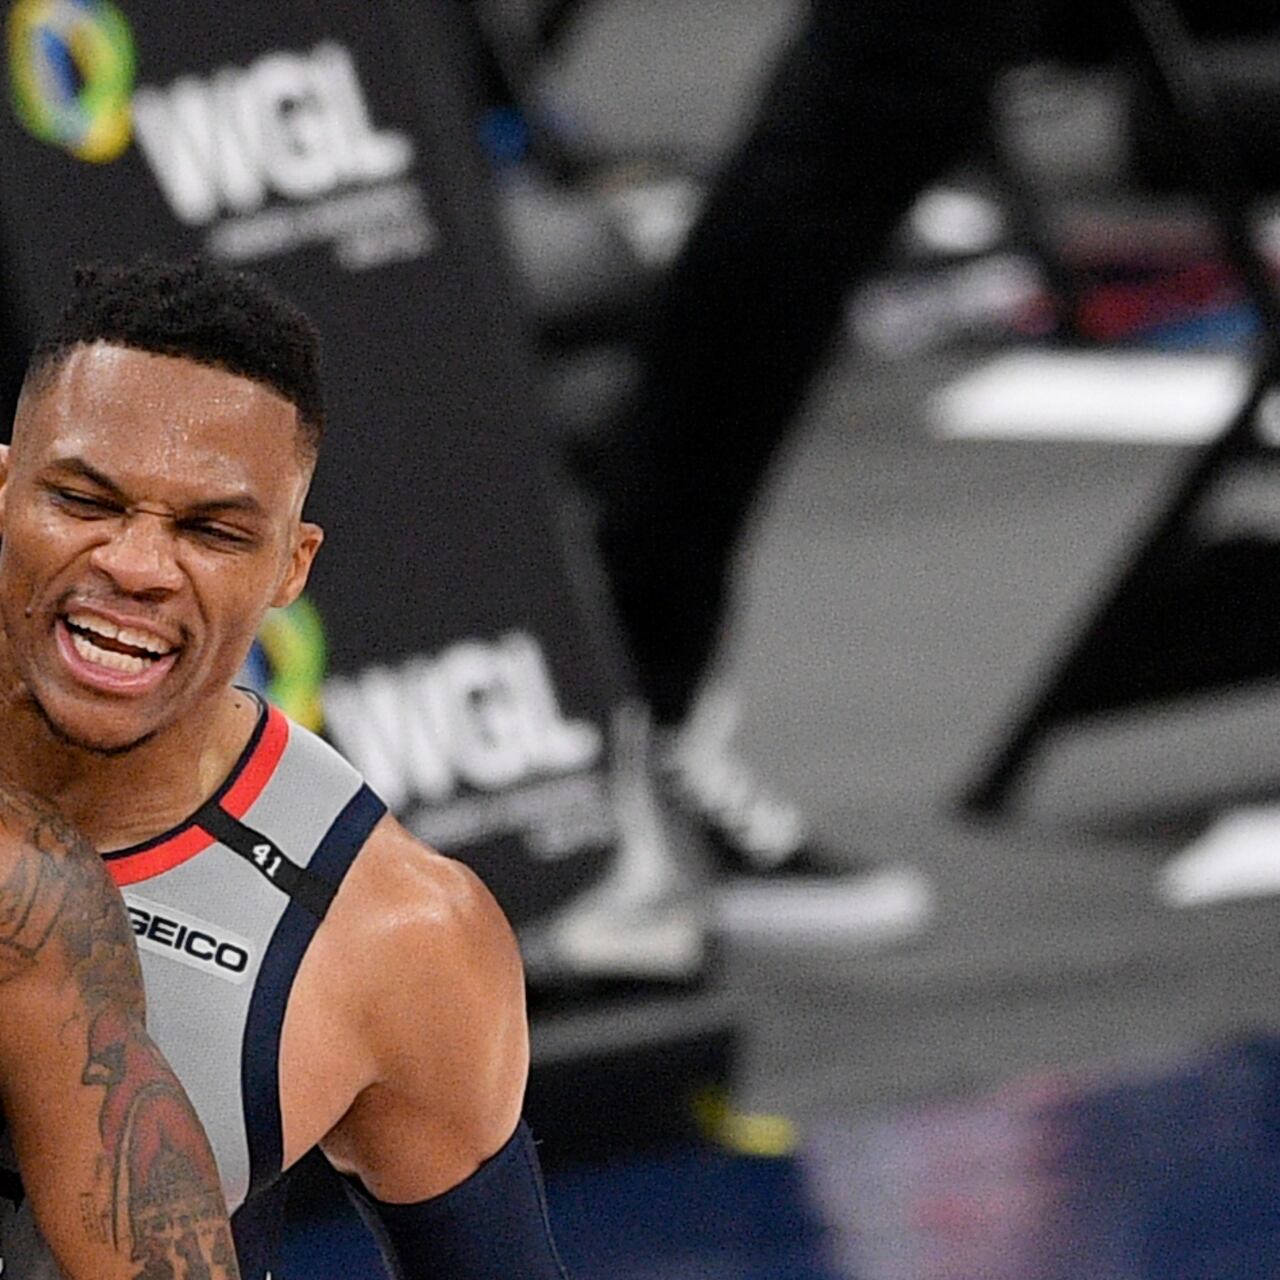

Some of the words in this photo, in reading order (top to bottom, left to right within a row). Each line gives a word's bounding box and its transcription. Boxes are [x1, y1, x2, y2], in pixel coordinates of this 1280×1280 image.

[131, 42, 415, 225] WGL
[321, 634, 601, 812] WGL
[253, 844, 282, 877] 41
[127, 906, 249, 973] GEICO
